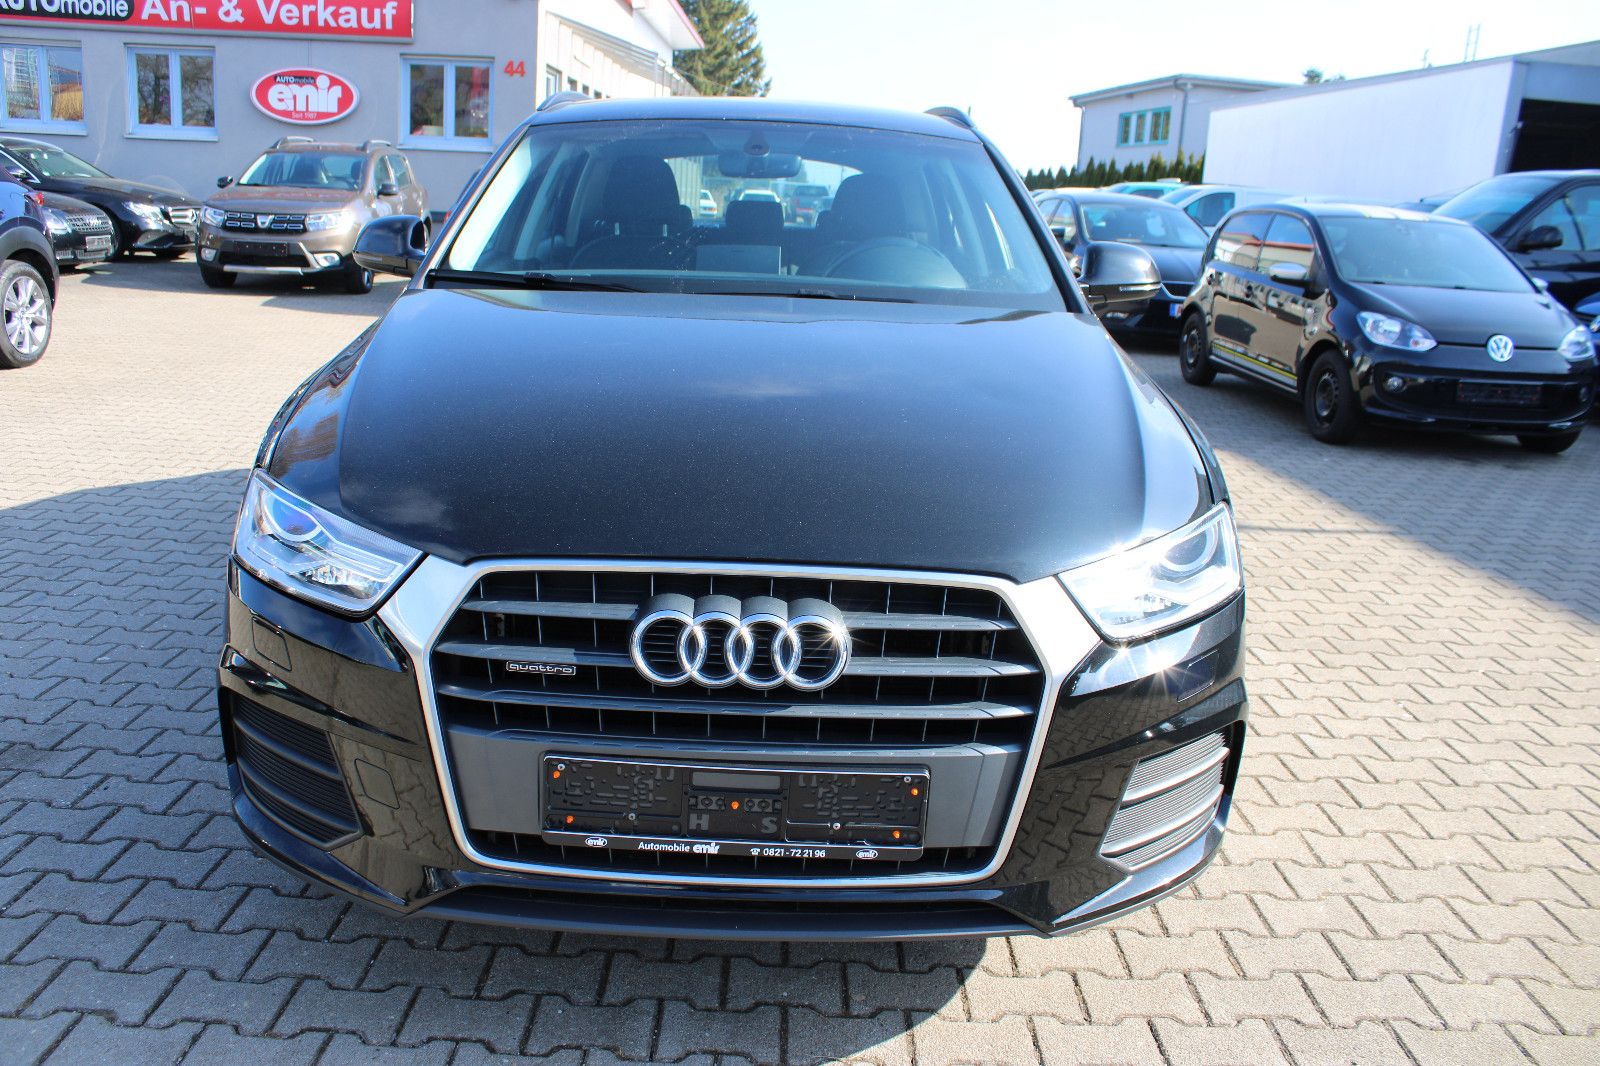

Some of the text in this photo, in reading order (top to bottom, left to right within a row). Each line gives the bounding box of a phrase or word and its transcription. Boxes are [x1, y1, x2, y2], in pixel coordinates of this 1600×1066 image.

[218, 0, 244, 24] &
[256, 0, 397, 30] Verkauf
[503, 59, 526, 77] 44
[276, 76, 315, 84] AUTOmobile
[268, 75, 342, 112] emir
[509, 663, 572, 673] quattro
[638, 841, 719, 854] Automobile emir
